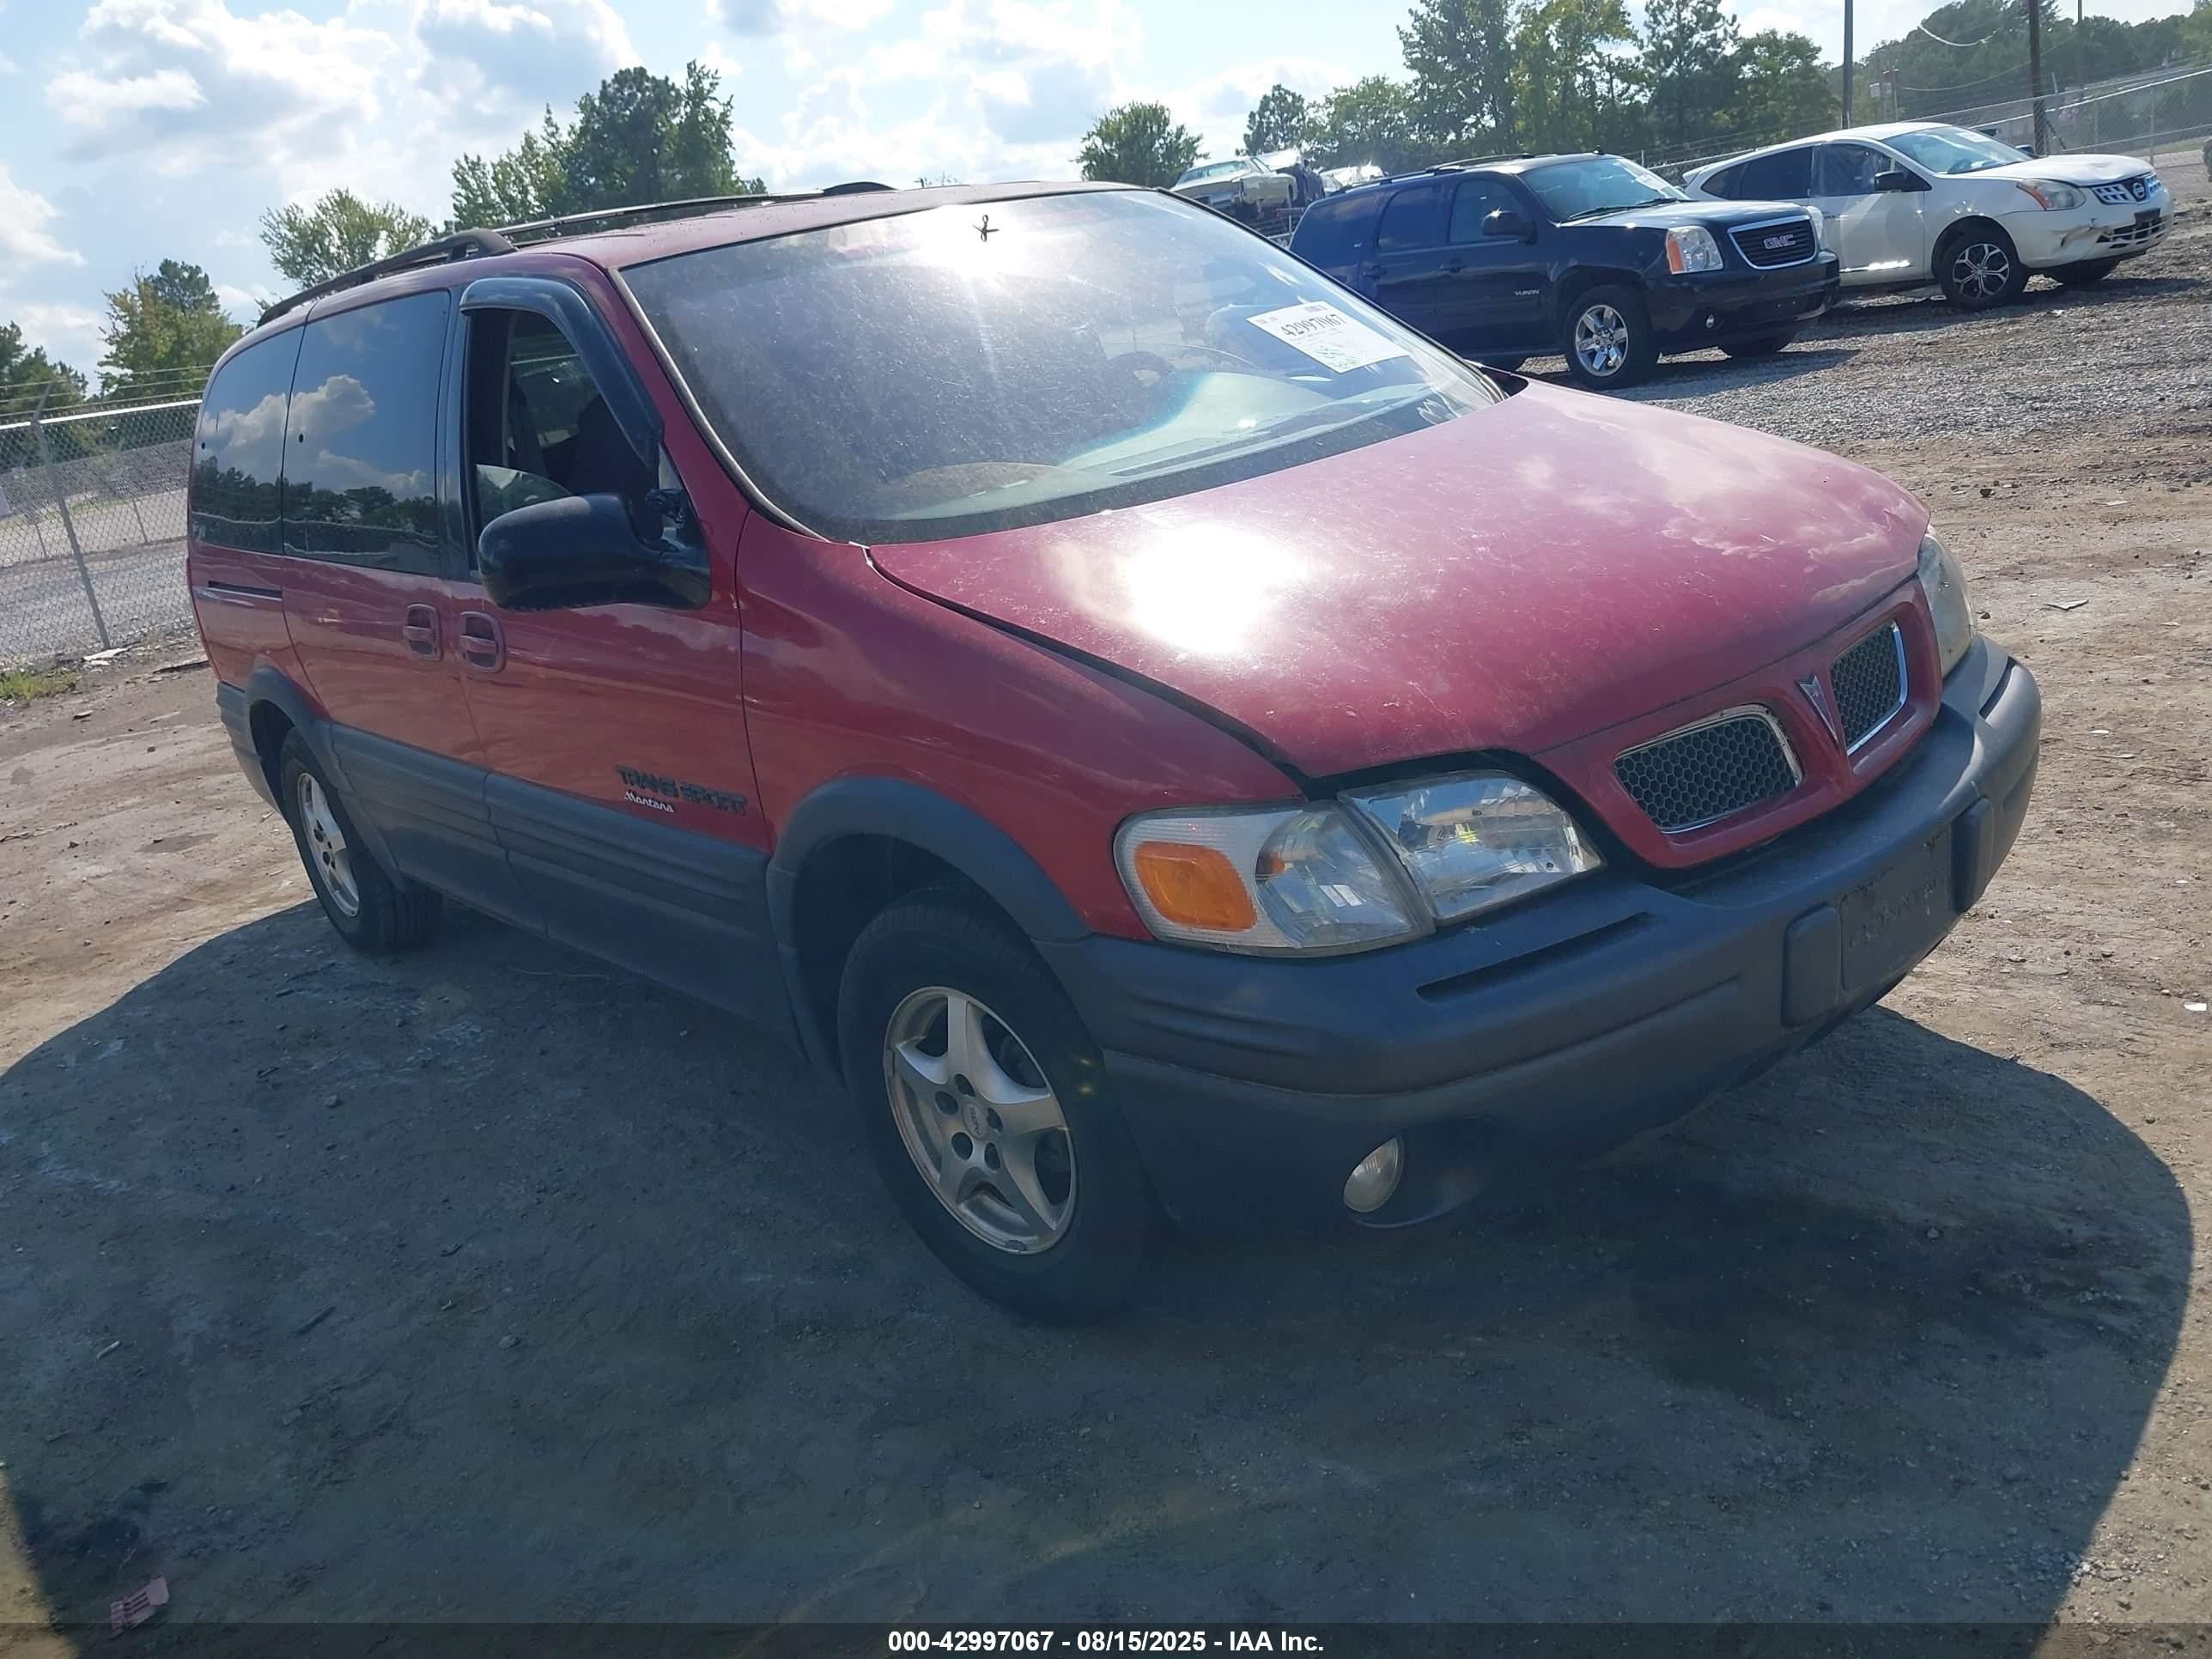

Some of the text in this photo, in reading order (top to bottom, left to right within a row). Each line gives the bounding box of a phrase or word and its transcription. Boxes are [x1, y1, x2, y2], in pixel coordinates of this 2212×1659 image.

[1763, 234, 1796, 250] GMC
[1280, 314, 1347, 337] 42997067
[623, 790, 674, 813] Montana
